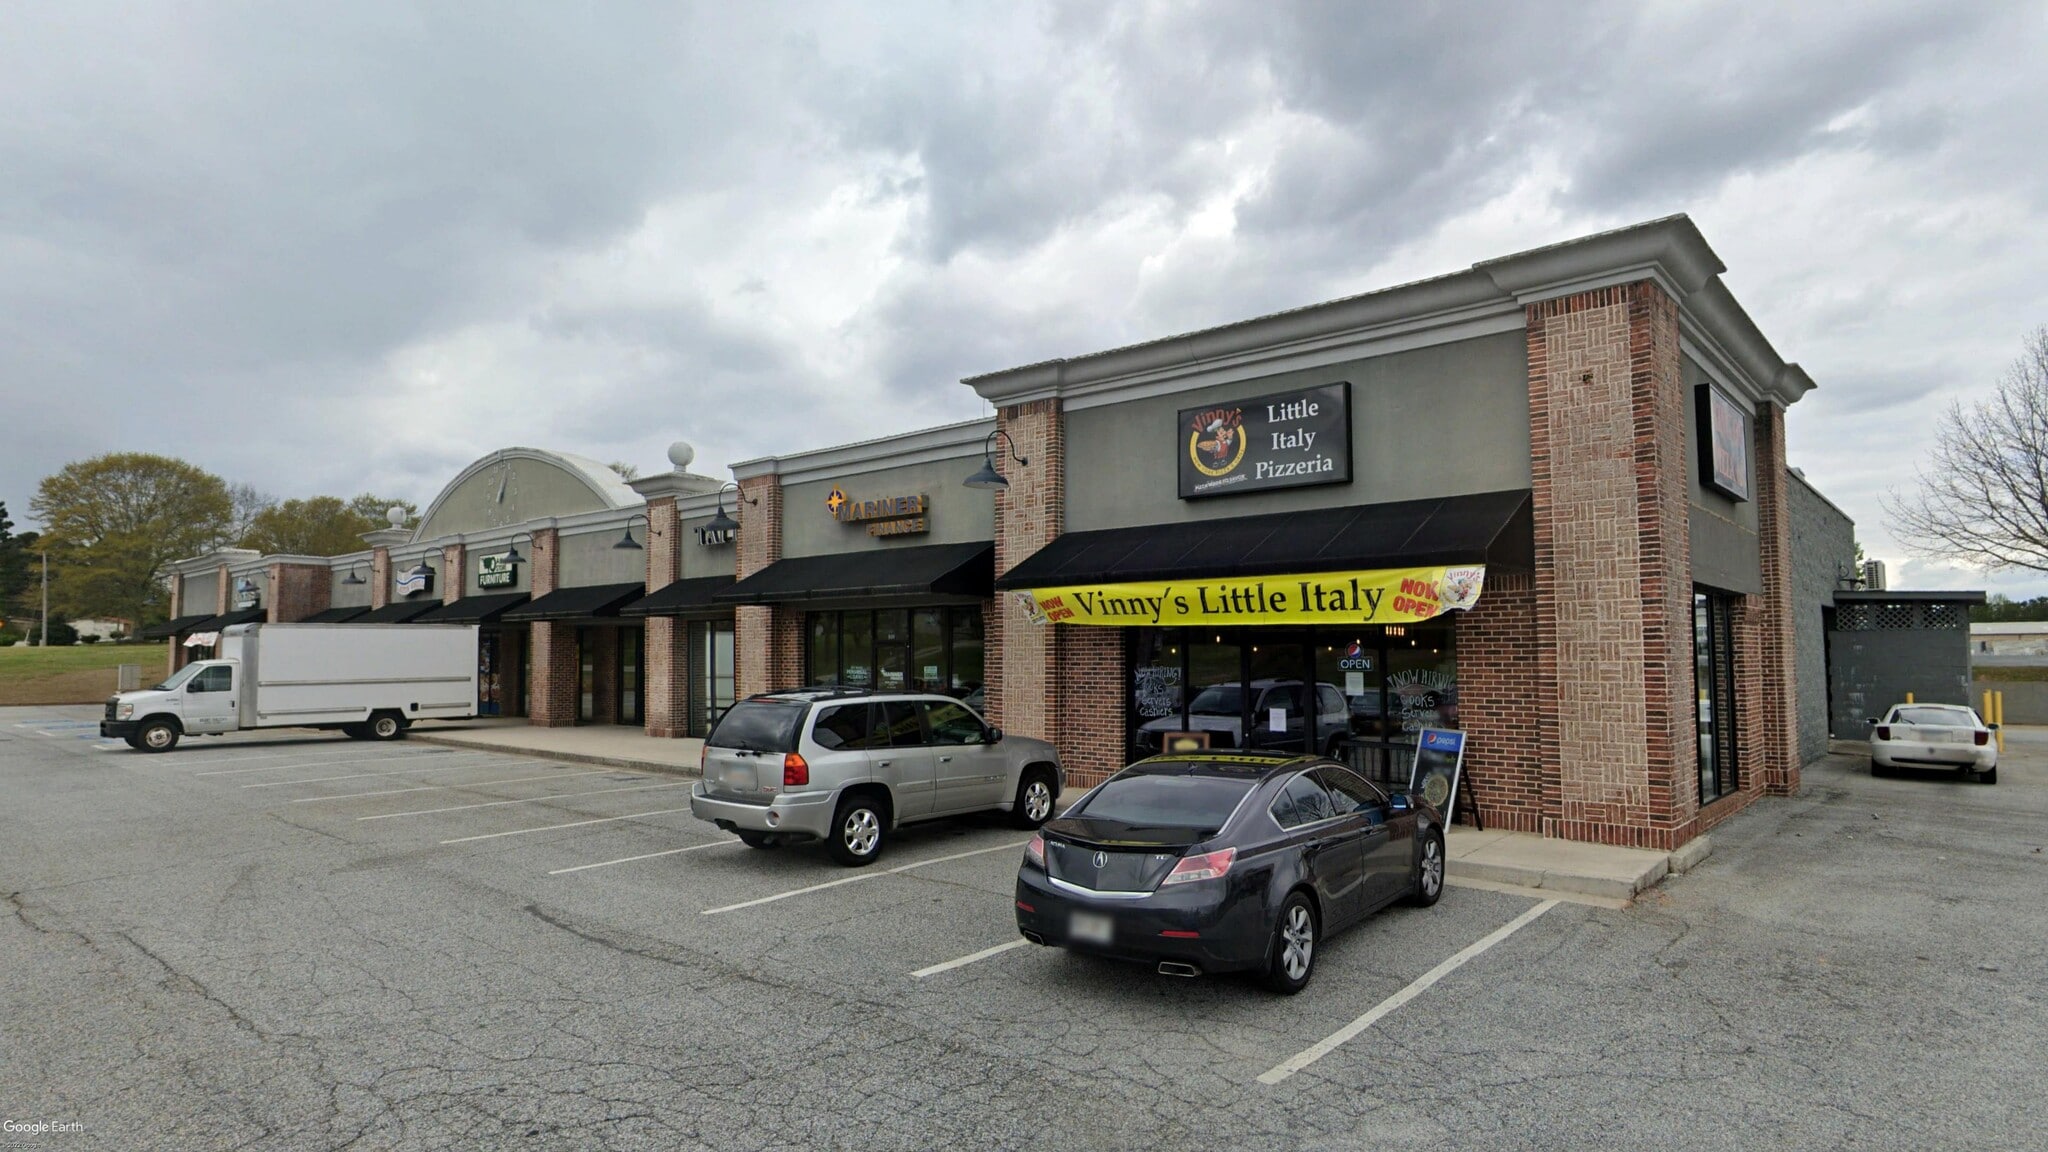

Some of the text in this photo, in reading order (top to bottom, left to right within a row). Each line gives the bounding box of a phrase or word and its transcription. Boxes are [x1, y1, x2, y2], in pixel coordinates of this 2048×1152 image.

[1191, 408, 1242, 432] Vinny's
[1266, 398, 1319, 423] Little
[1271, 428, 1316, 451] Italy
[1255, 454, 1333, 479] Pizzeria
[837, 495, 922, 521] MARINER
[865, 518, 924, 537] FINANCE
[480, 571, 510, 586] FURNITURE
[1039, 596, 1064, 611] NOW
[1072, 578, 1385, 623] Vinny's Little Italy
[1393, 595, 1439, 617] OPEN
[1047, 607, 1075, 622] OPEN
[1340, 659, 1370, 669] OPEN
